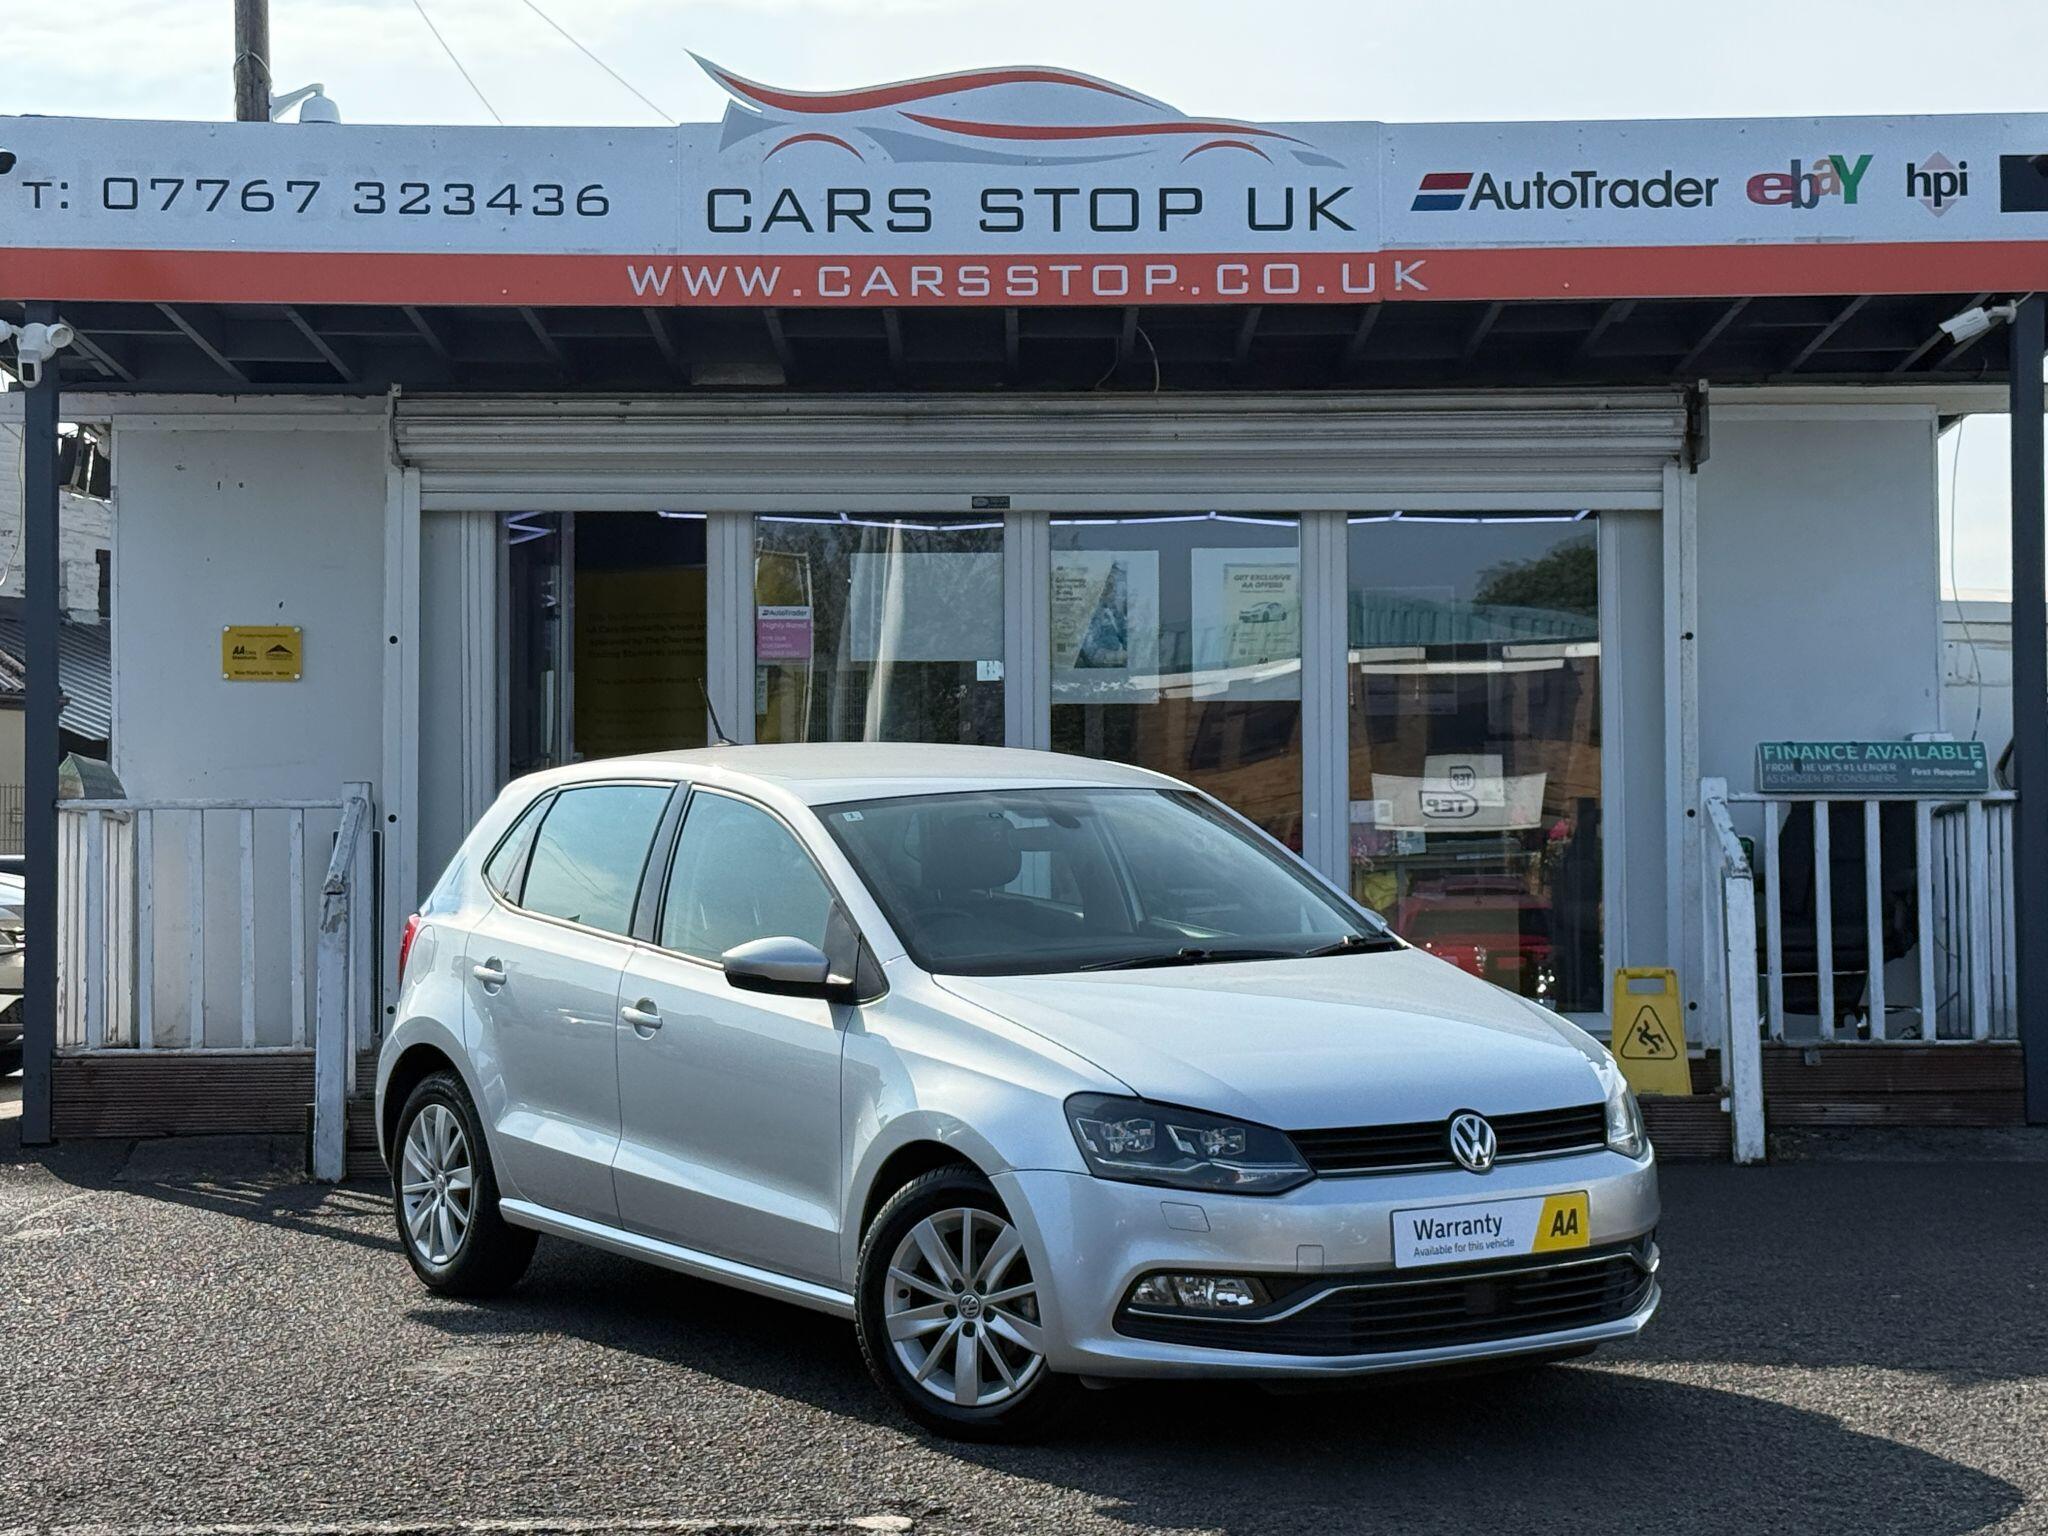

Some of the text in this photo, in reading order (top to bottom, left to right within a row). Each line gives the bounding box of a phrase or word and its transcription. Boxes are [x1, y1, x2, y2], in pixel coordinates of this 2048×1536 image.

[22, 177, 611, 218] T: 07767 323436
[1468, 169, 1720, 211] AutoTrader
[1906, 160, 1970, 208] hpi
[706, 186, 1357, 234] CARS STOP UK
[626, 258, 1429, 298] WWW.CARSSTOP.CO.UK
[1763, 744, 1983, 761] FINANCE AVAILABLE
[1413, 1212, 1504, 1241] Warranty
[1550, 1207, 1579, 1238] AA
[1413, 1237, 1515, 1258] Available for this vehicle
